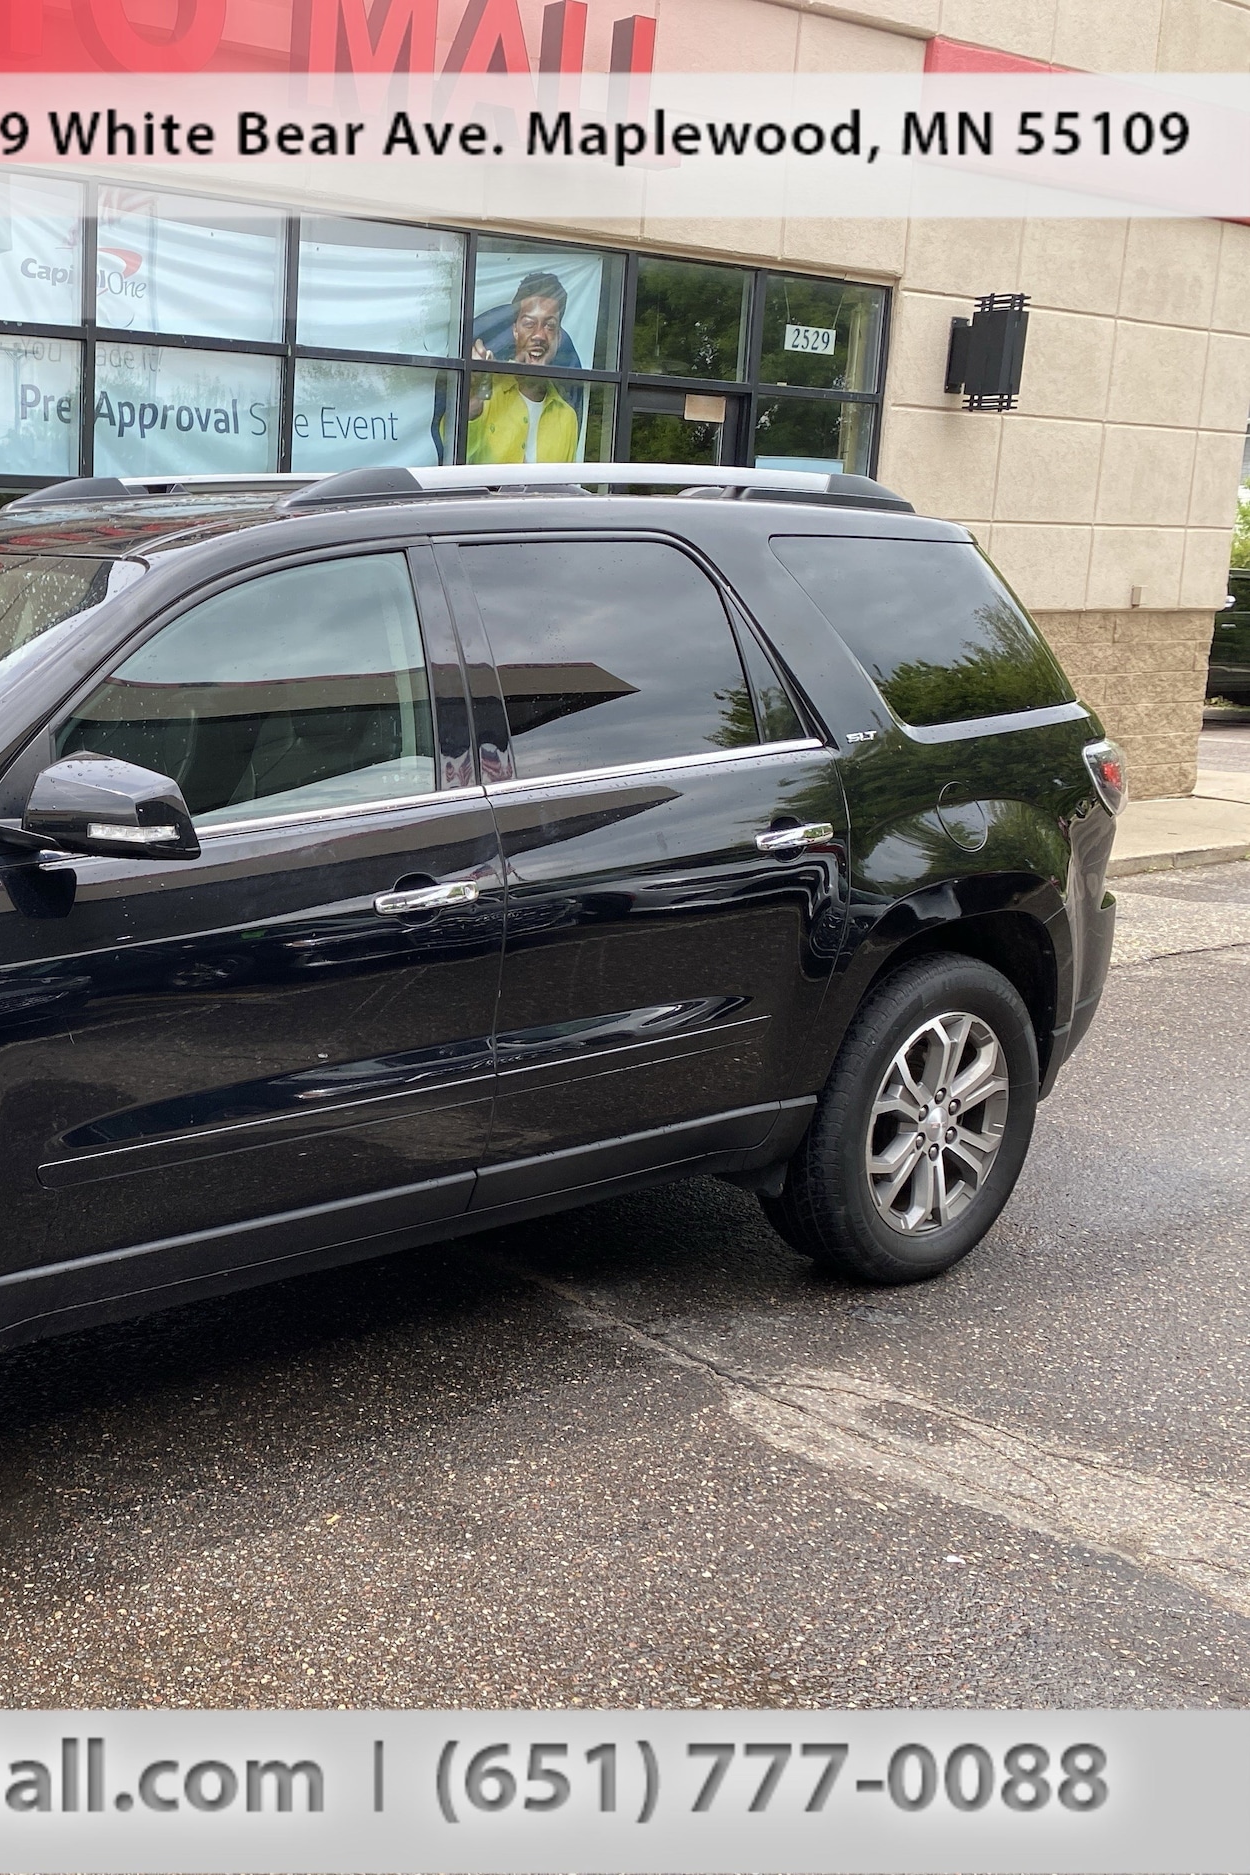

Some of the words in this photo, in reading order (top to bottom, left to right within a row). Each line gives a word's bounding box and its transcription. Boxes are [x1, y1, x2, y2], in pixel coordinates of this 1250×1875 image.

[791, 328, 830, 351] 2529
[96, 346, 136, 371] ade
[320, 406, 399, 441] Event
